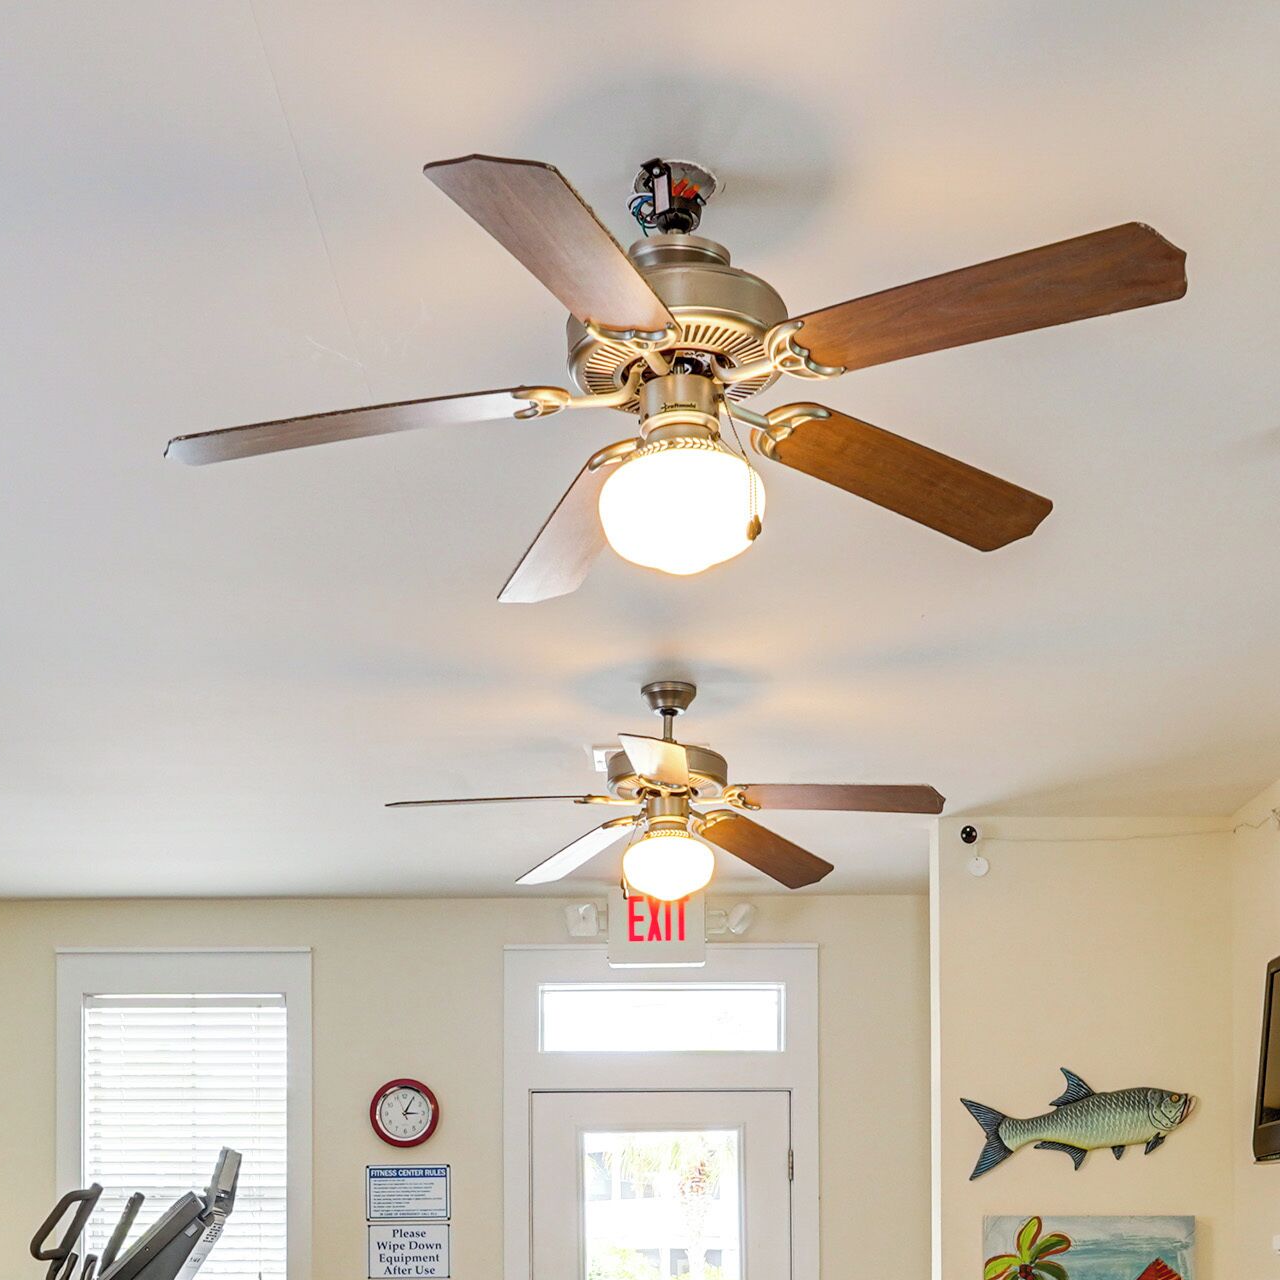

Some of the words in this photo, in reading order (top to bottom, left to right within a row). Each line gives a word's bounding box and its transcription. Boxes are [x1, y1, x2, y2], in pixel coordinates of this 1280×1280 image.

[628, 895, 690, 942] EXIT
[370, 1169, 397, 1177] FITNESS
[392, 1228, 426, 1238] Please
[377, 1241, 406, 1253] Wipe
[408, 1240, 442, 1250] Down
[379, 1253, 439, 1265] Equipment
[384, 1265, 412, 1275] After
[415, 1265, 436, 1275] Use
